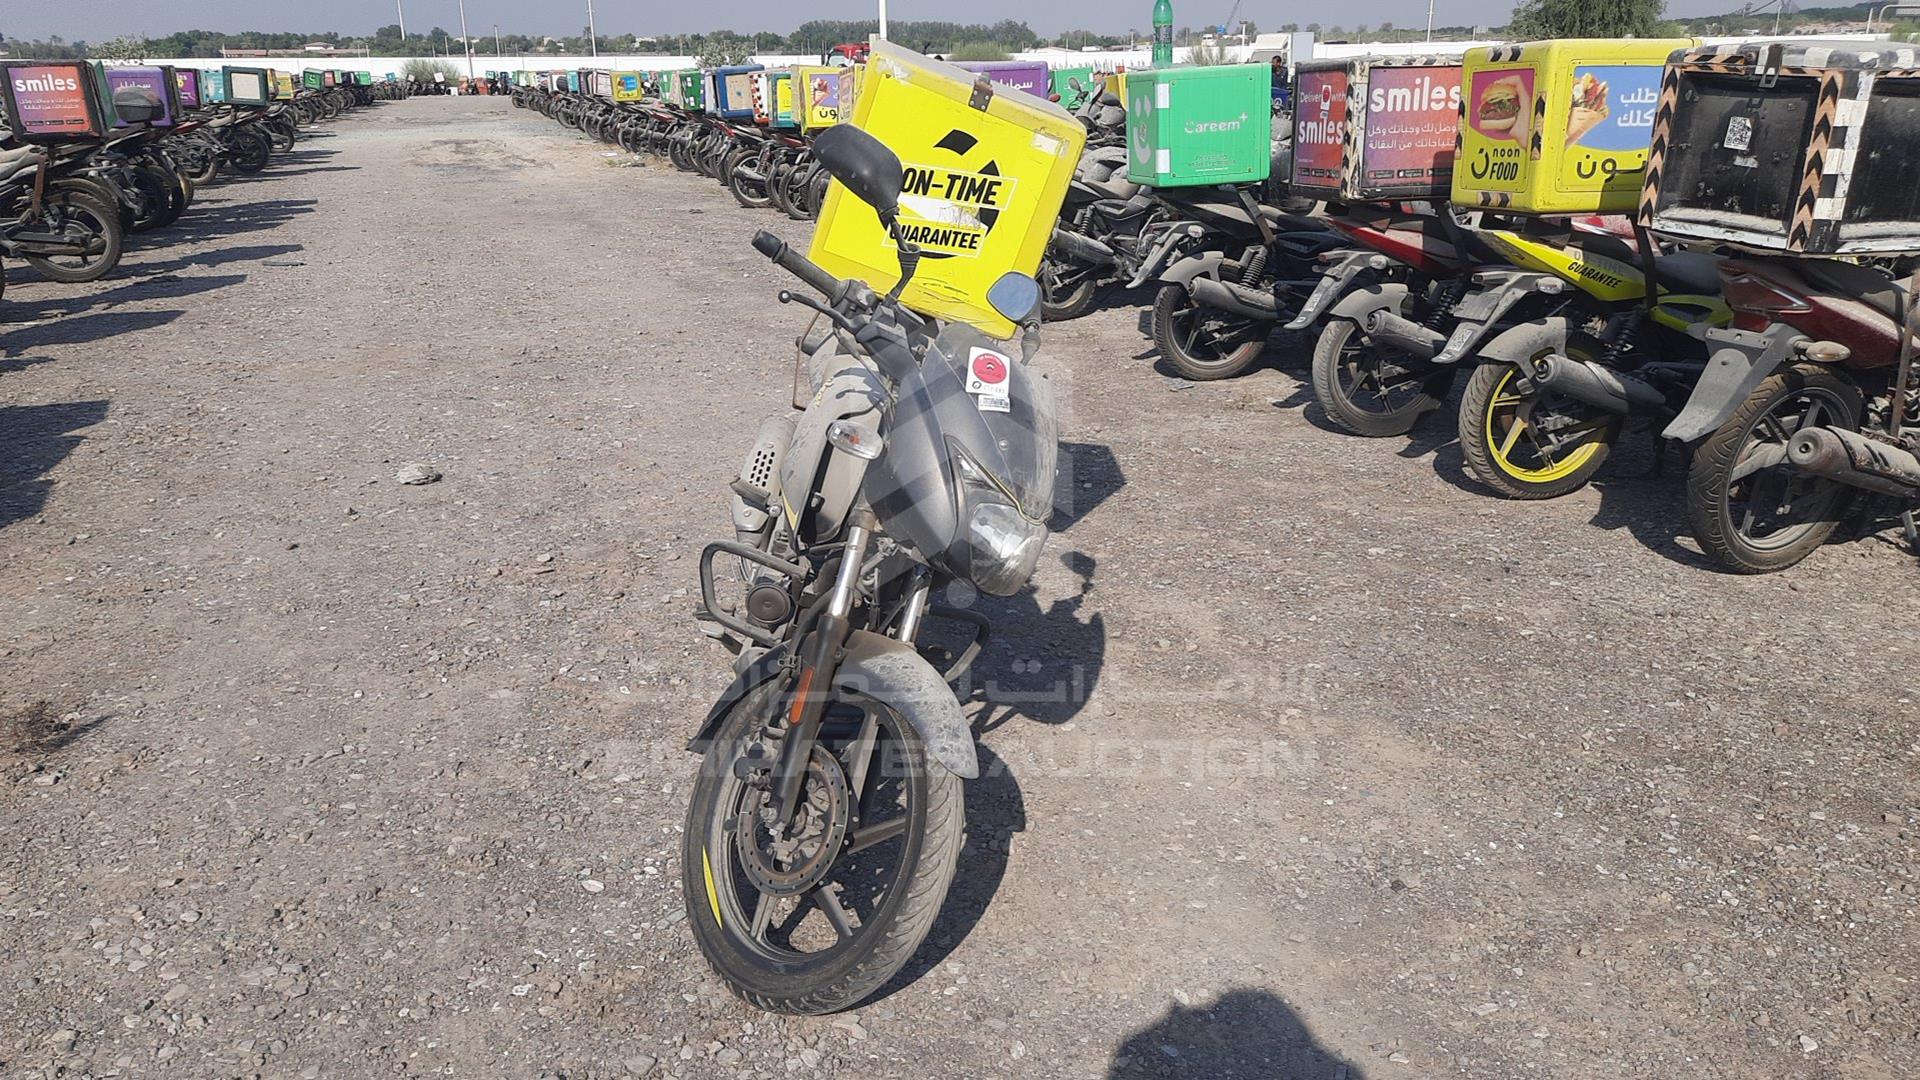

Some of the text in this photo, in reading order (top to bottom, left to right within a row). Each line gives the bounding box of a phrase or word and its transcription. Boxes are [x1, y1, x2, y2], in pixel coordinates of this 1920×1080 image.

[15, 73, 77, 92] smiles
[1370, 76, 1461, 113] smiles
[1620, 87, 1658, 107] طلب
[1617, 108, 1656, 127] كلك
[1298, 117, 1344, 145] smiles
[1492, 147, 1520, 159] noon
[1489, 162, 1519, 181] FOOD
[901, 167, 1002, 206] ON-TIME
[1567, 261, 1622, 289] GUARANTEE
